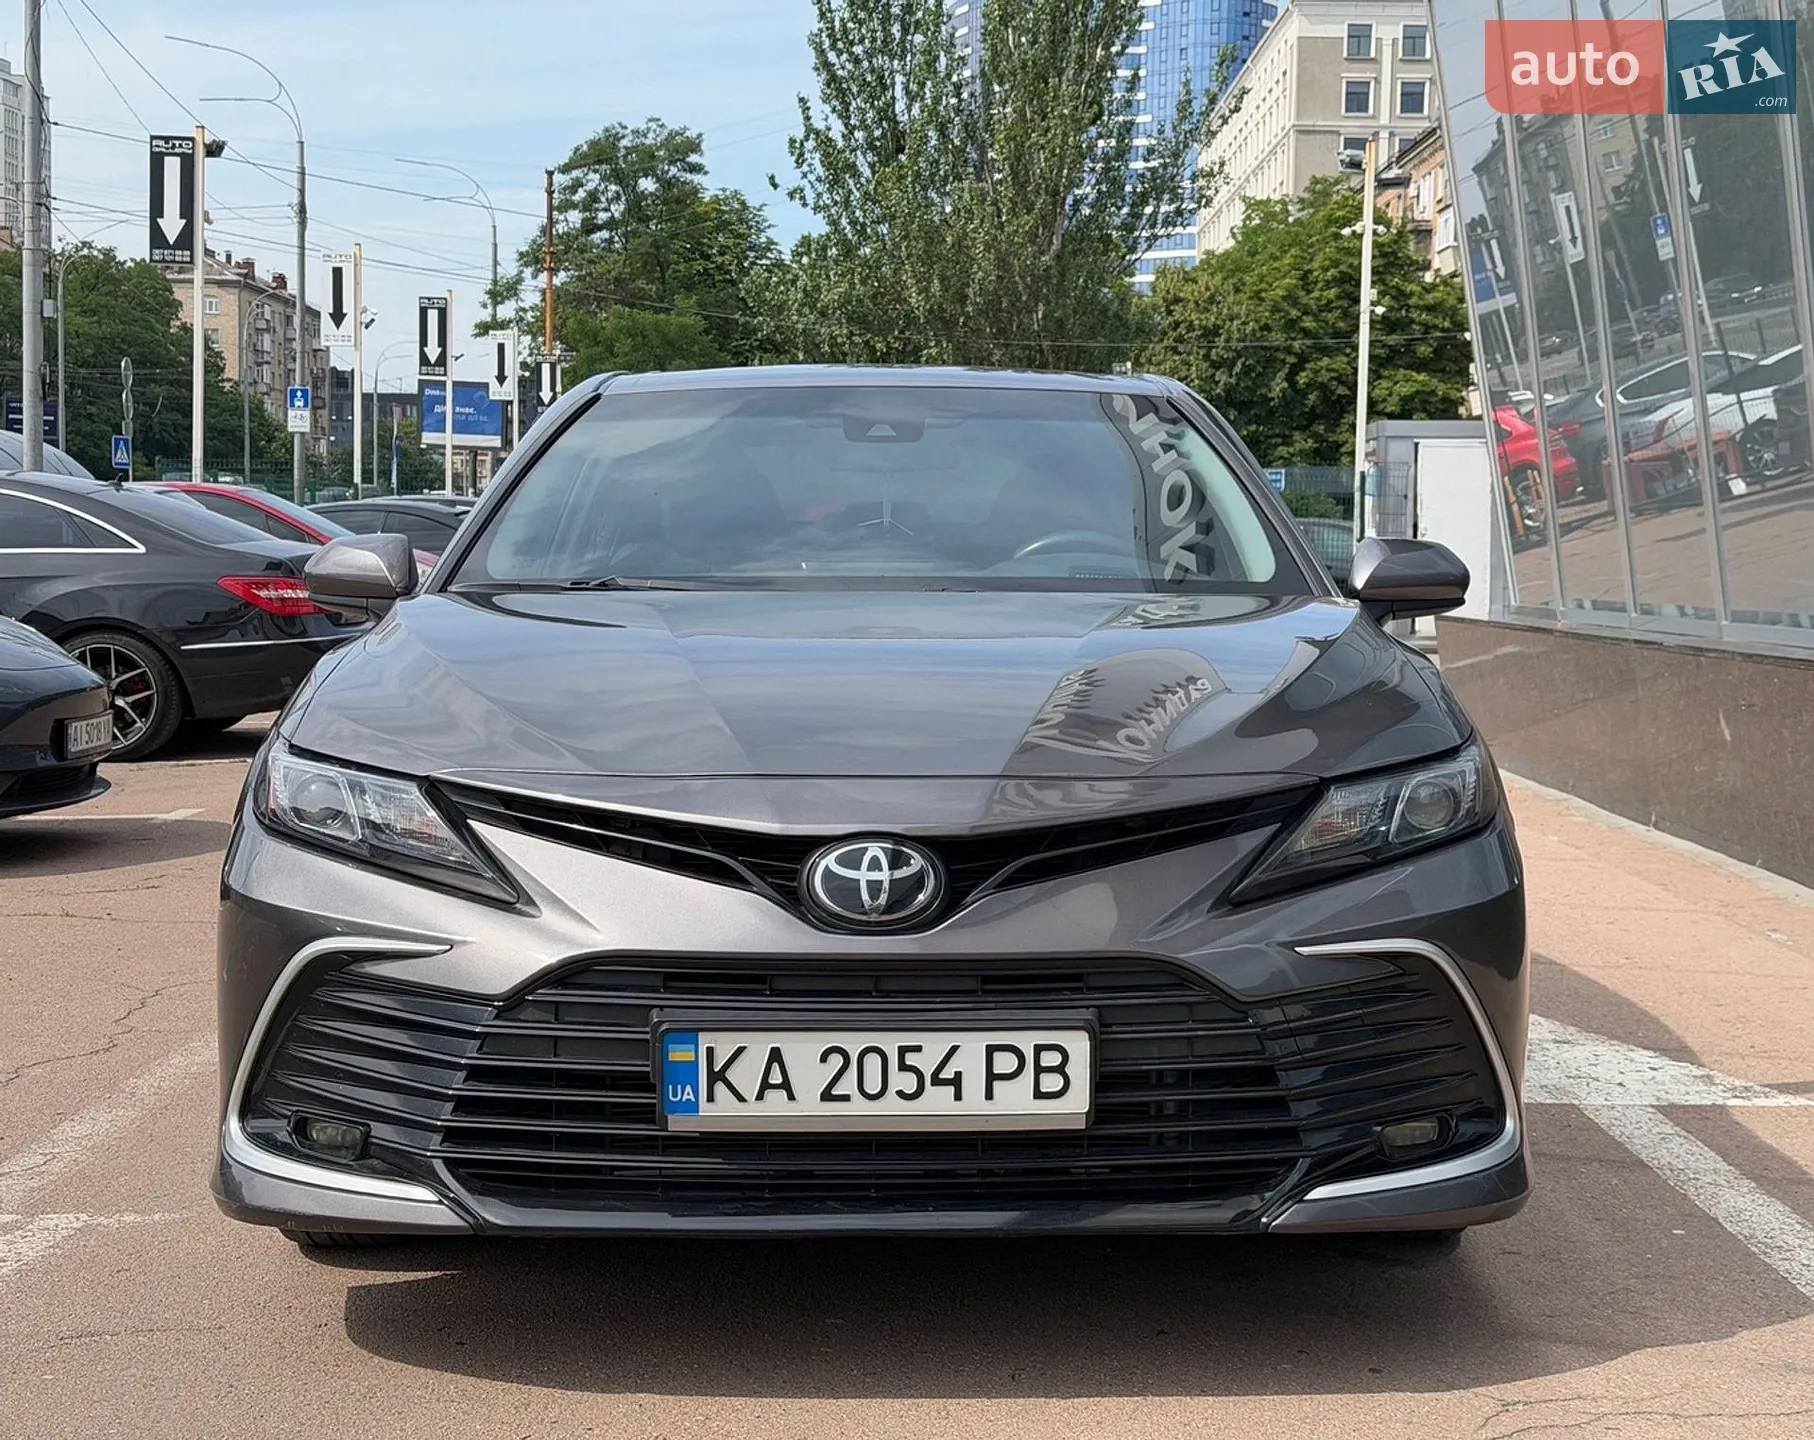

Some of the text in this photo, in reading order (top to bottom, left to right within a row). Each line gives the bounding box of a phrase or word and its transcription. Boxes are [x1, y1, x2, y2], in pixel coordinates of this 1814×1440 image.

[152, 139, 193, 148] AUTO
[704, 1043, 1071, 1103] KA 2054 PB
[668, 1085, 696, 1102] UA
